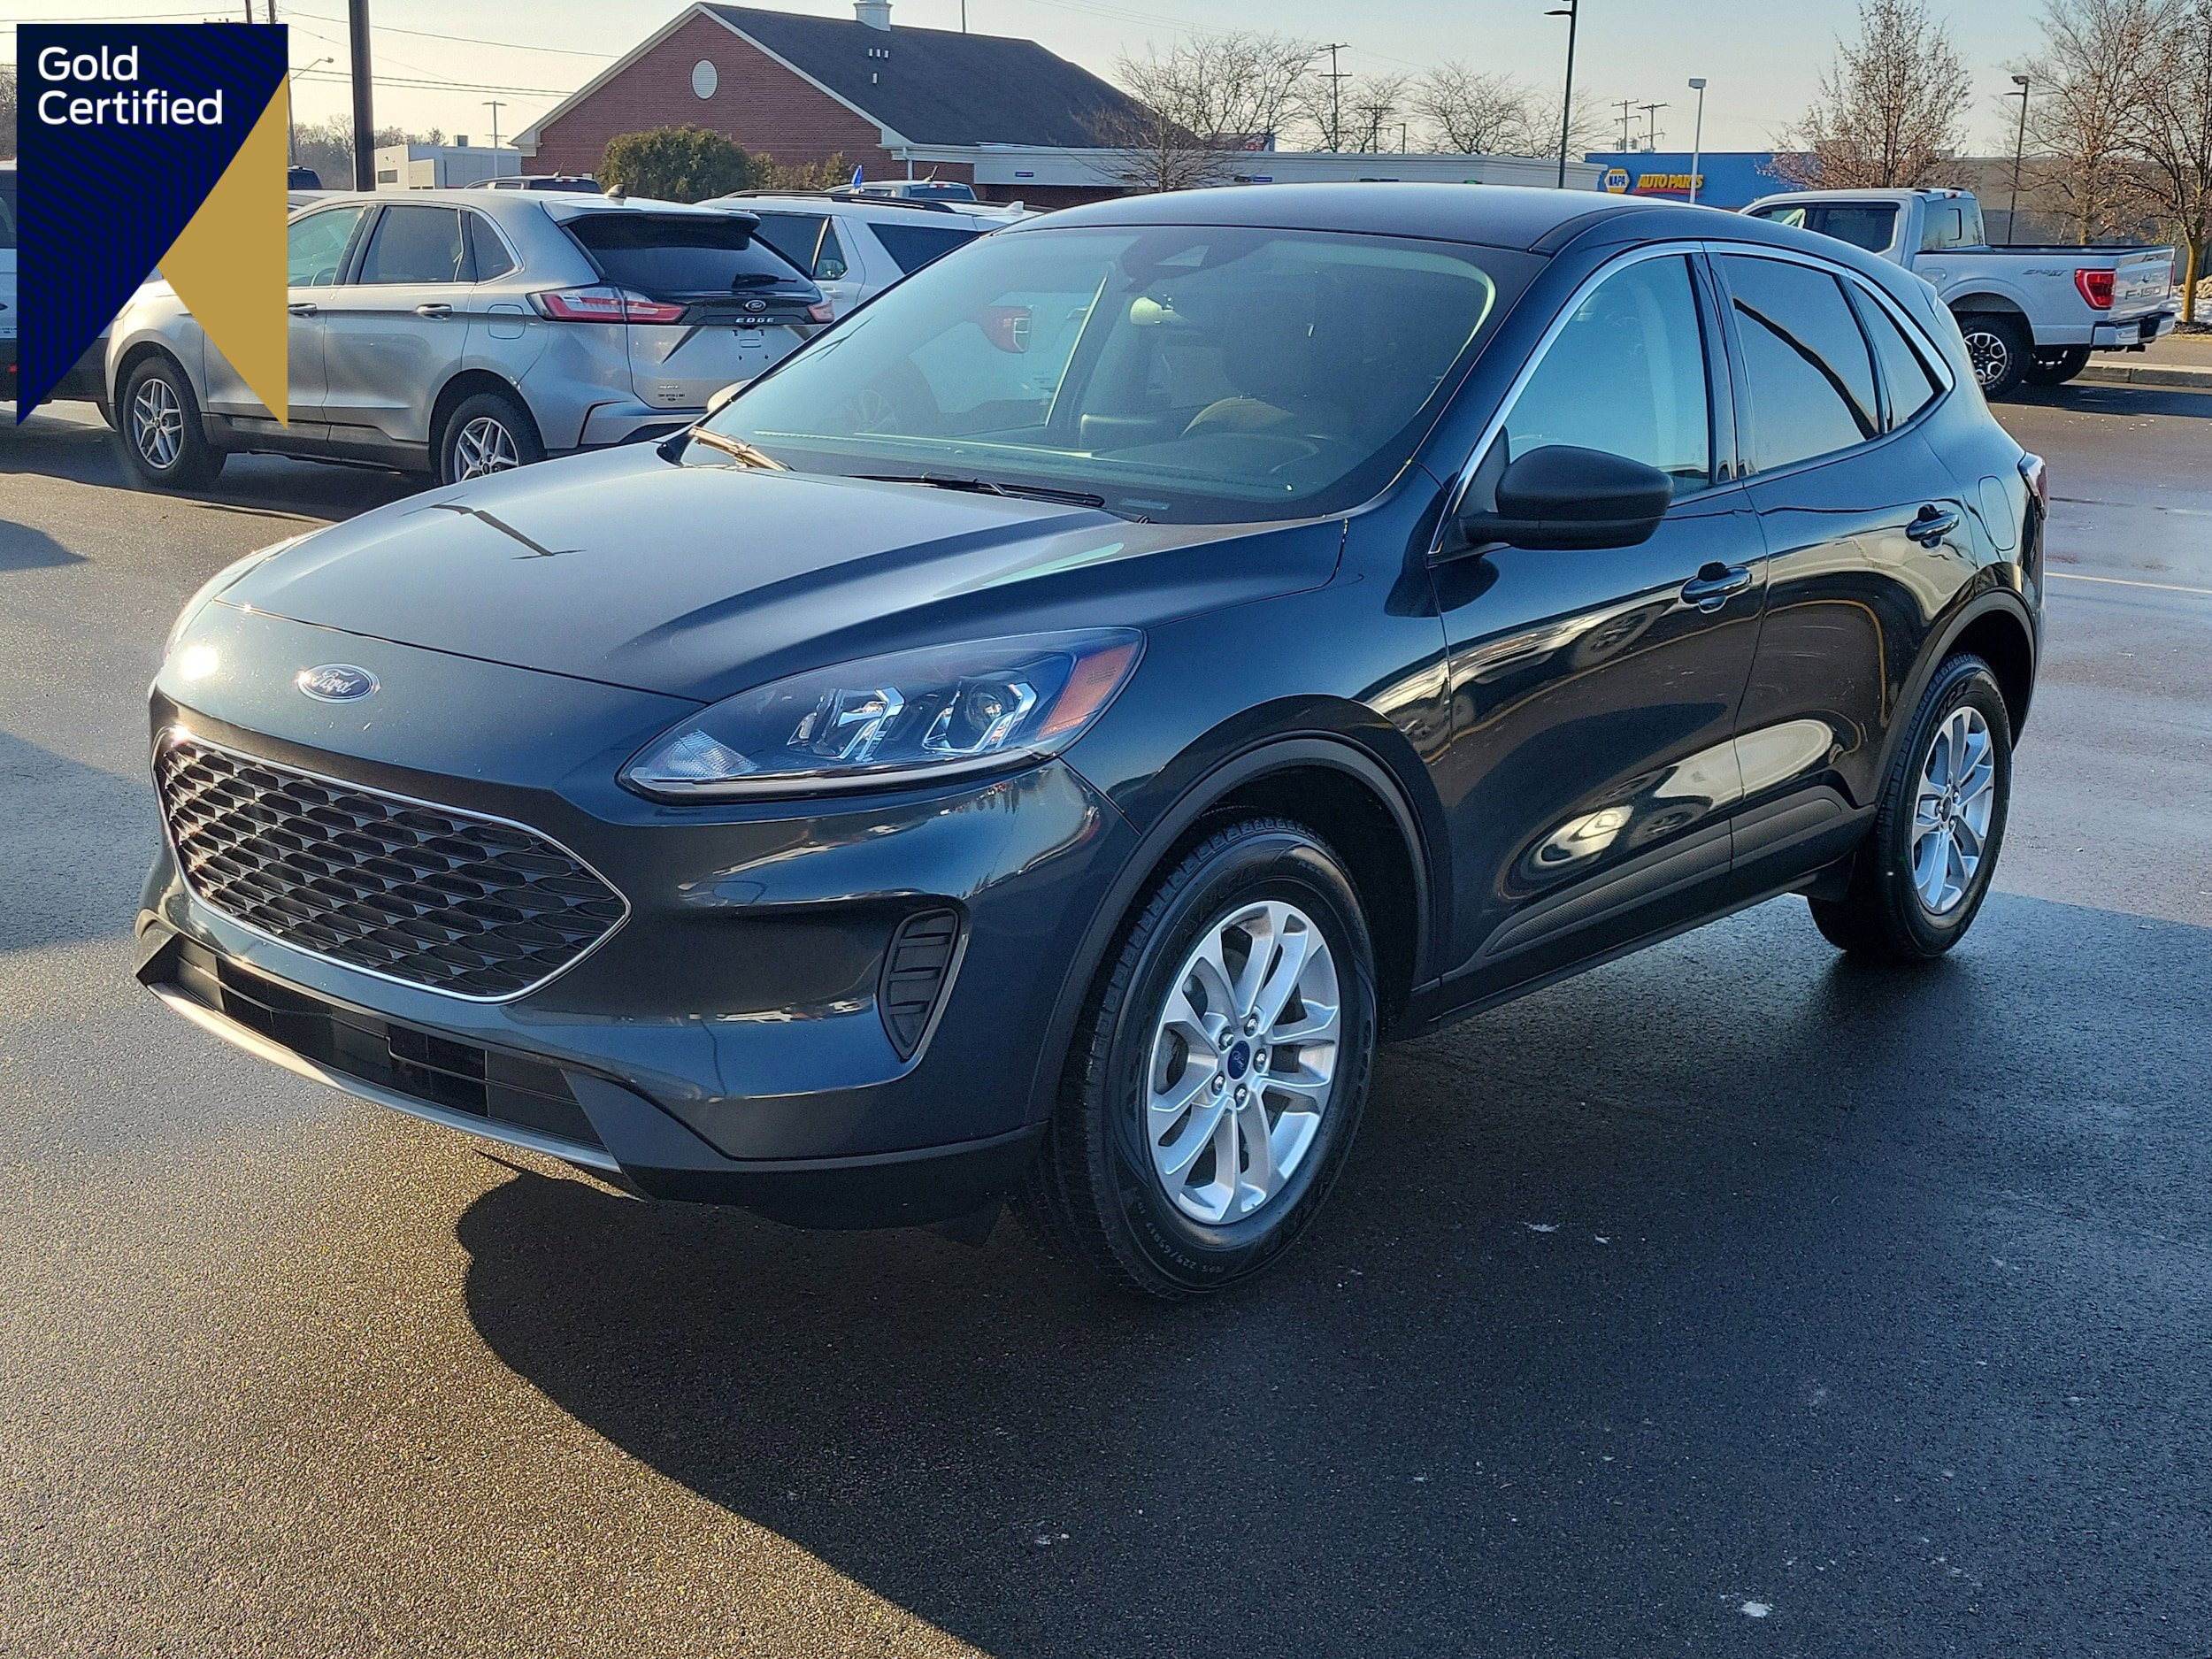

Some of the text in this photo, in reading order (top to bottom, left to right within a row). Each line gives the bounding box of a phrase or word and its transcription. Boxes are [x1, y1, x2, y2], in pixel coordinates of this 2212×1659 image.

[1609, 175, 1626, 186] NAPA
[1637, 174, 1668, 188] AUTO
[2124, 285, 2162, 300] F-150
[311, 668, 360, 693] Ford
